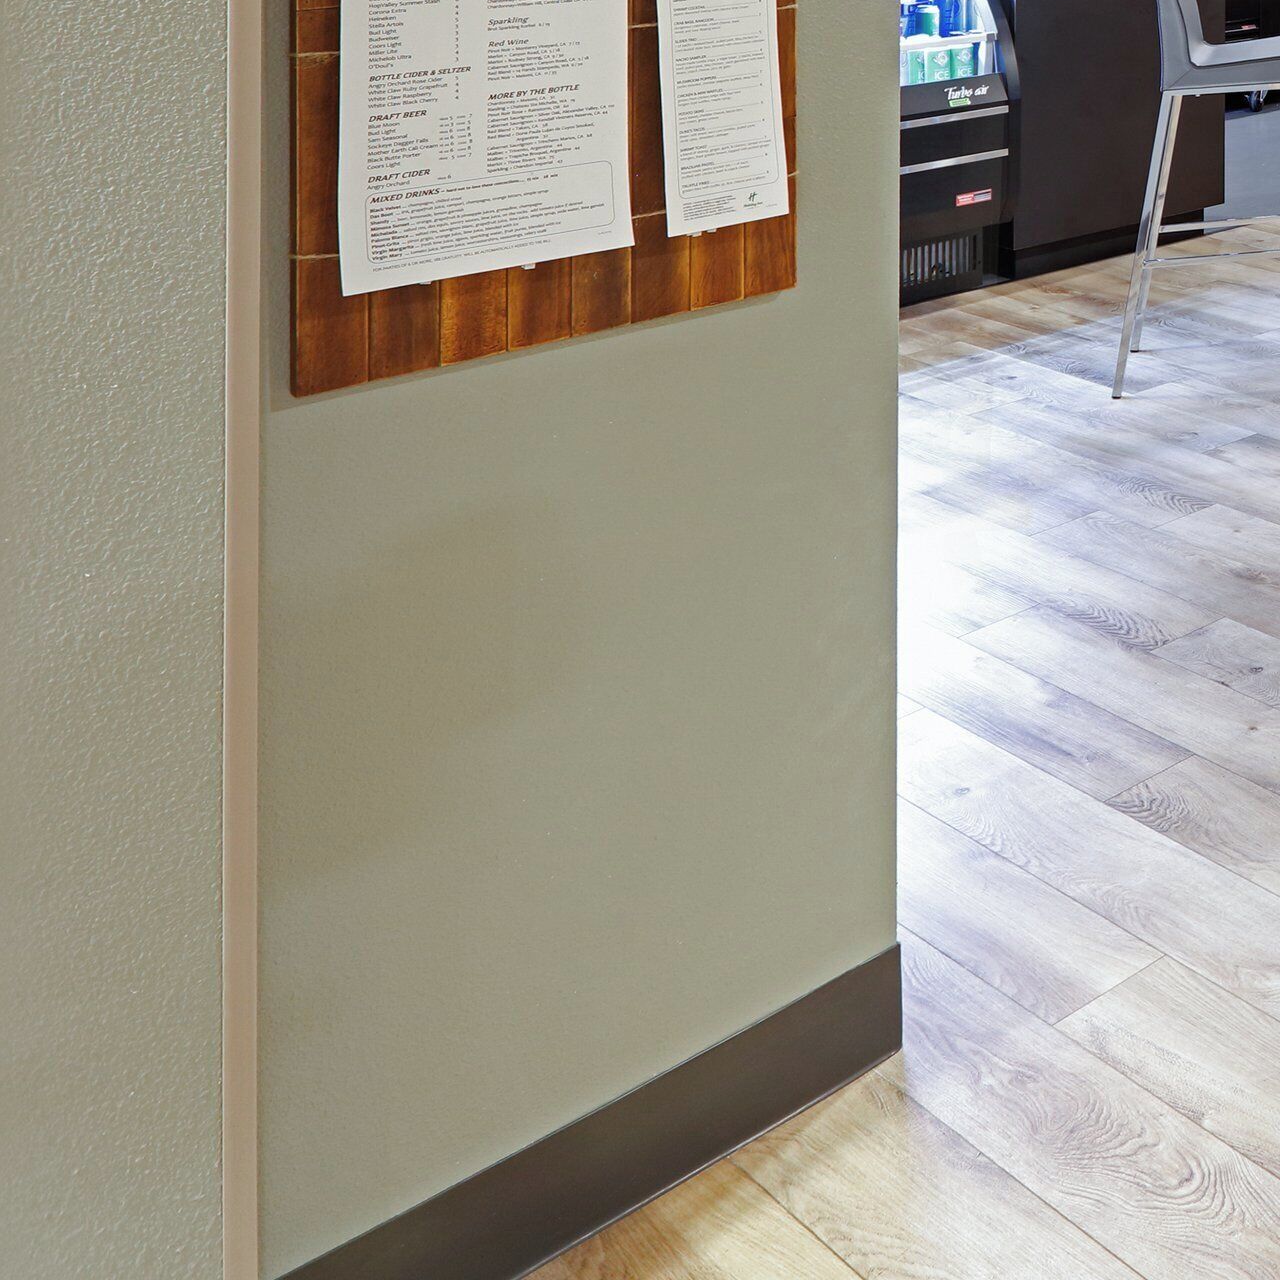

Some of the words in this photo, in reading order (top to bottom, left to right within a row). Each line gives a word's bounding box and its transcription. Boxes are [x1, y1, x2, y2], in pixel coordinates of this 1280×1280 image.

[488, 16, 530, 26] Sparkling
[369, 73, 402, 82] BOTTLE
[403, 71, 429, 79] CIDER
[437, 67, 471, 75] SELTZER
[934, 70, 949, 80] ICE
[958, 68, 972, 77] ICE
[403, 92, 432, 100] Raspberry
[488, 92, 514, 101] MORE
[530, 88, 547, 96] THE
[548, 85, 580, 94] BOTTLE
[944, 86, 973, 100] Turbo
[974, 85, 989, 95] air
[369, 113, 402, 122] DRAFT
[403, 110, 427, 118] BEER
[368, 173, 401, 183] DRAFT
[402, 169, 431, 179] CIDER
[370, 194, 403, 204] MIXED
[405, 188, 440, 199] DRINKS
